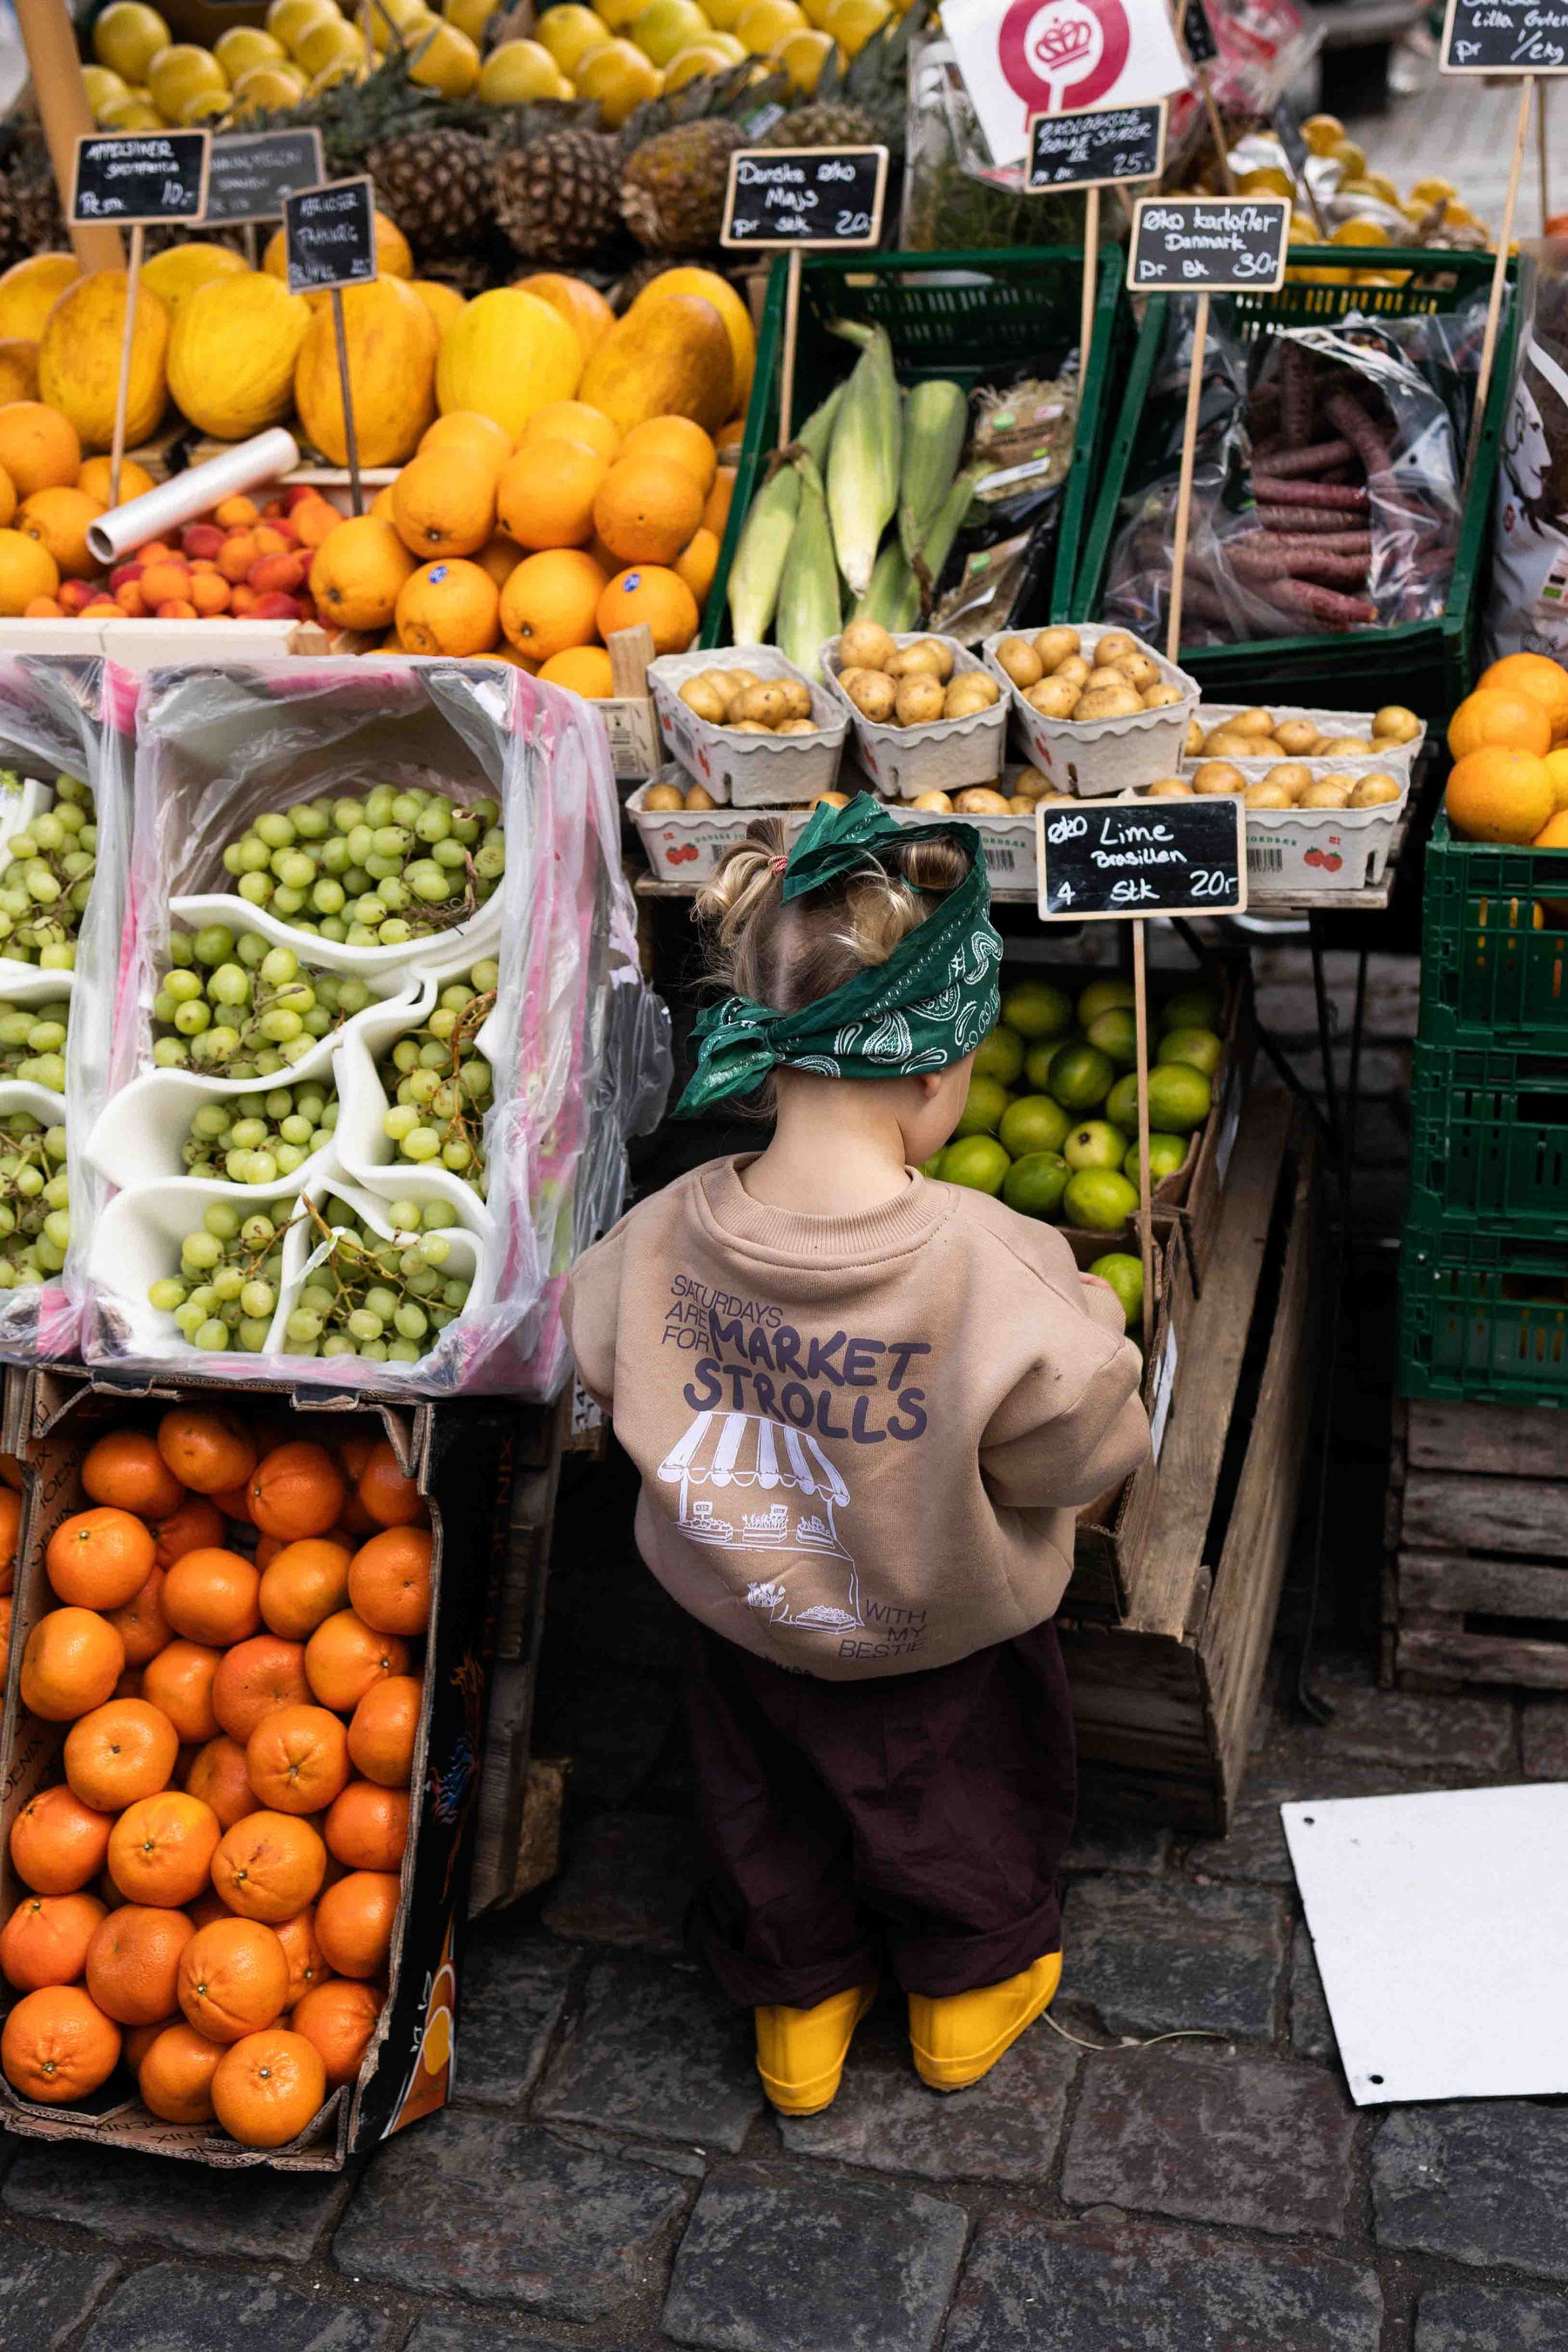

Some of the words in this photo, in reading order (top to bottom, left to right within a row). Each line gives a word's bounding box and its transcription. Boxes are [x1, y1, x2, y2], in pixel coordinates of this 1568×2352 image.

[737, 160, 806, 185] Danske
[764, 186, 819, 212] Majs
[1164, 232, 1247, 252] Danmark
[1099, 817, 1174, 845] Lime
[1057, 881, 1076, 905] 4
[670, 1274, 784, 1328] SATURDAYS
[665, 1301, 707, 1330] ARE
[661, 1325, 709, 1353] FOR
[708, 1308, 931, 1391] MARKET
[683, 1357, 928, 1443] STROLLS
[866, 1599, 926, 1625] WITH
[888, 1625, 929, 1642] MY
[838, 1639, 925, 1659] BESTIE
